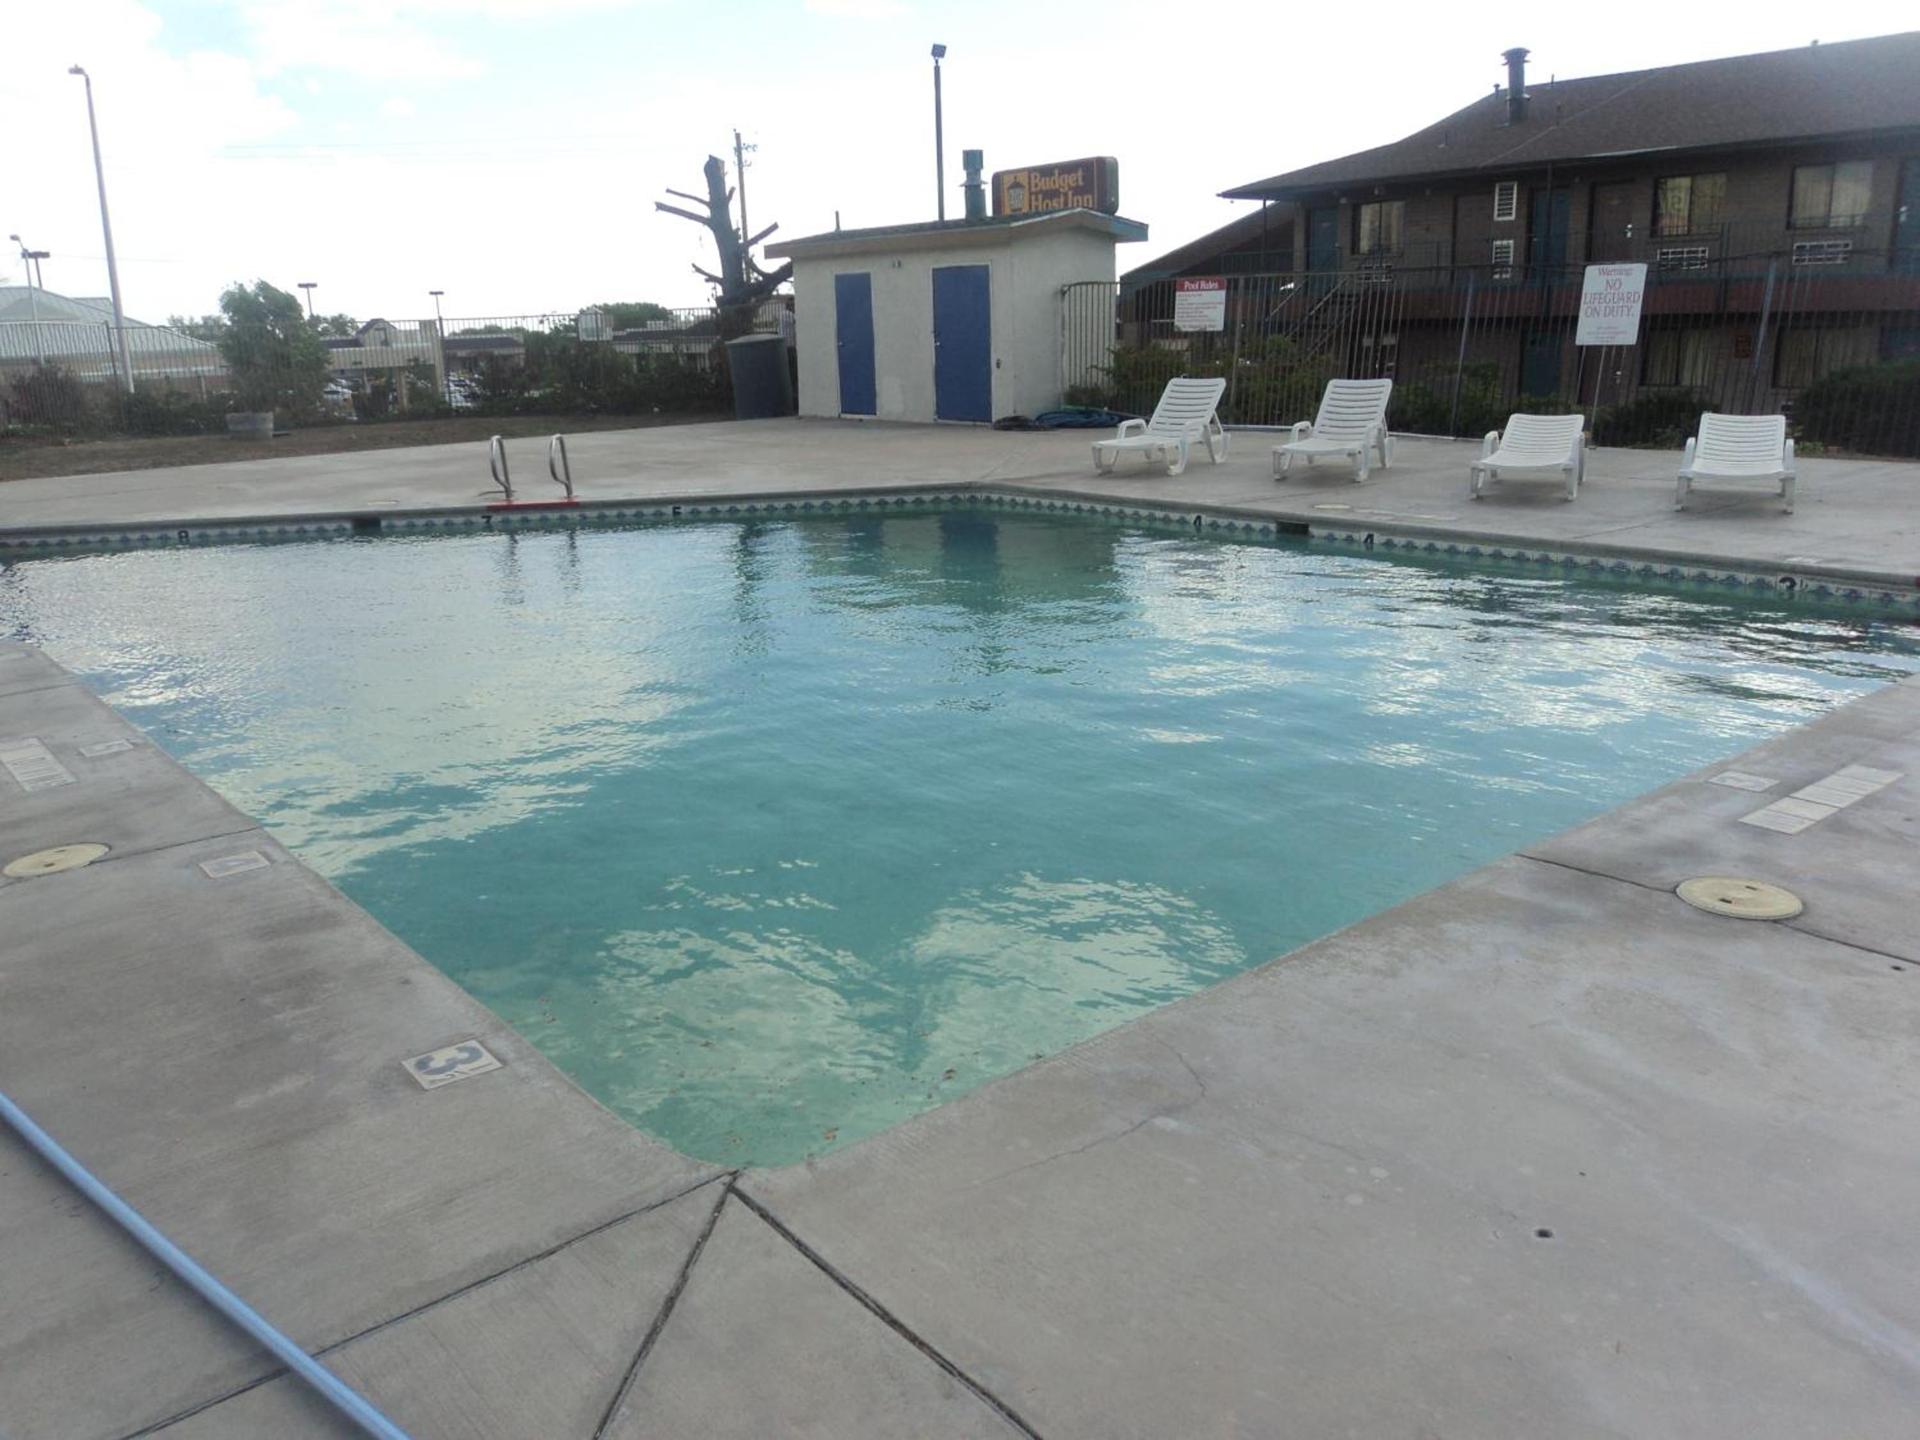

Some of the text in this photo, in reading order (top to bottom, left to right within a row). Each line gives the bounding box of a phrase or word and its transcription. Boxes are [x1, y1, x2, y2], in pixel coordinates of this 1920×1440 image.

[1030, 168, 1084, 192] Budget
[1031, 191, 1093, 211] Host Inn
[1605, 279, 1622, 291] NO
[1583, 292, 1640, 305] LIFEGUARD
[1585, 305, 1600, 318] ON
